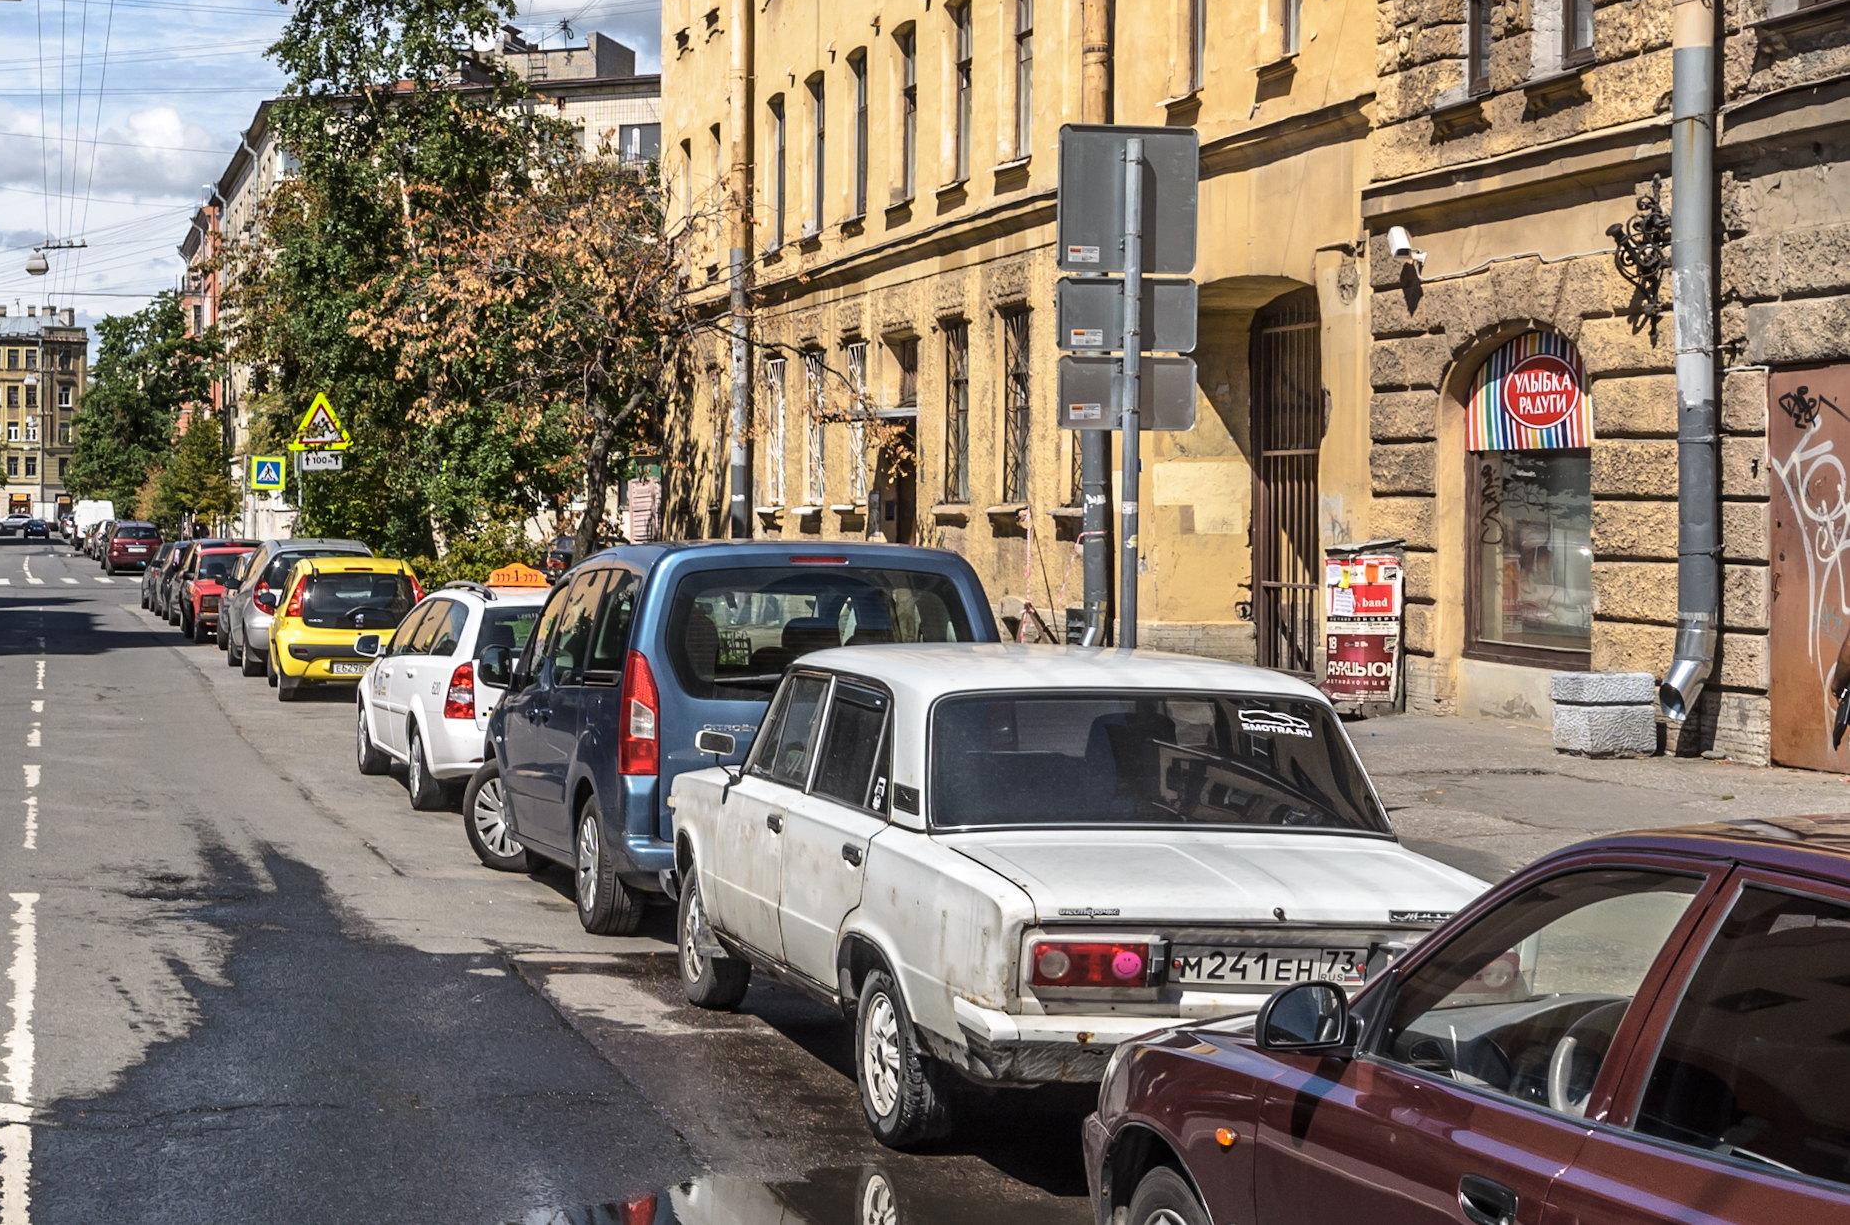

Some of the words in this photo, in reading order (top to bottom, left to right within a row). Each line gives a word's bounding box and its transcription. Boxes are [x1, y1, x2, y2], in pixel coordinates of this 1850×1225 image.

[1514, 371, 1572, 393] УЛЫБКА
[1519, 394, 1567, 415] РАДУГИ
[313, 456, 327, 464] 100
[1362, 597, 1388, 608] band
[1328, 636, 1337, 649] 18
[1241, 723, 1313, 738] SMOTRA.RU
[1181, 951, 1314, 981] М241ЕН
[1326, 951, 1357, 973] 73
[1320, 973, 1343, 981] RUS
